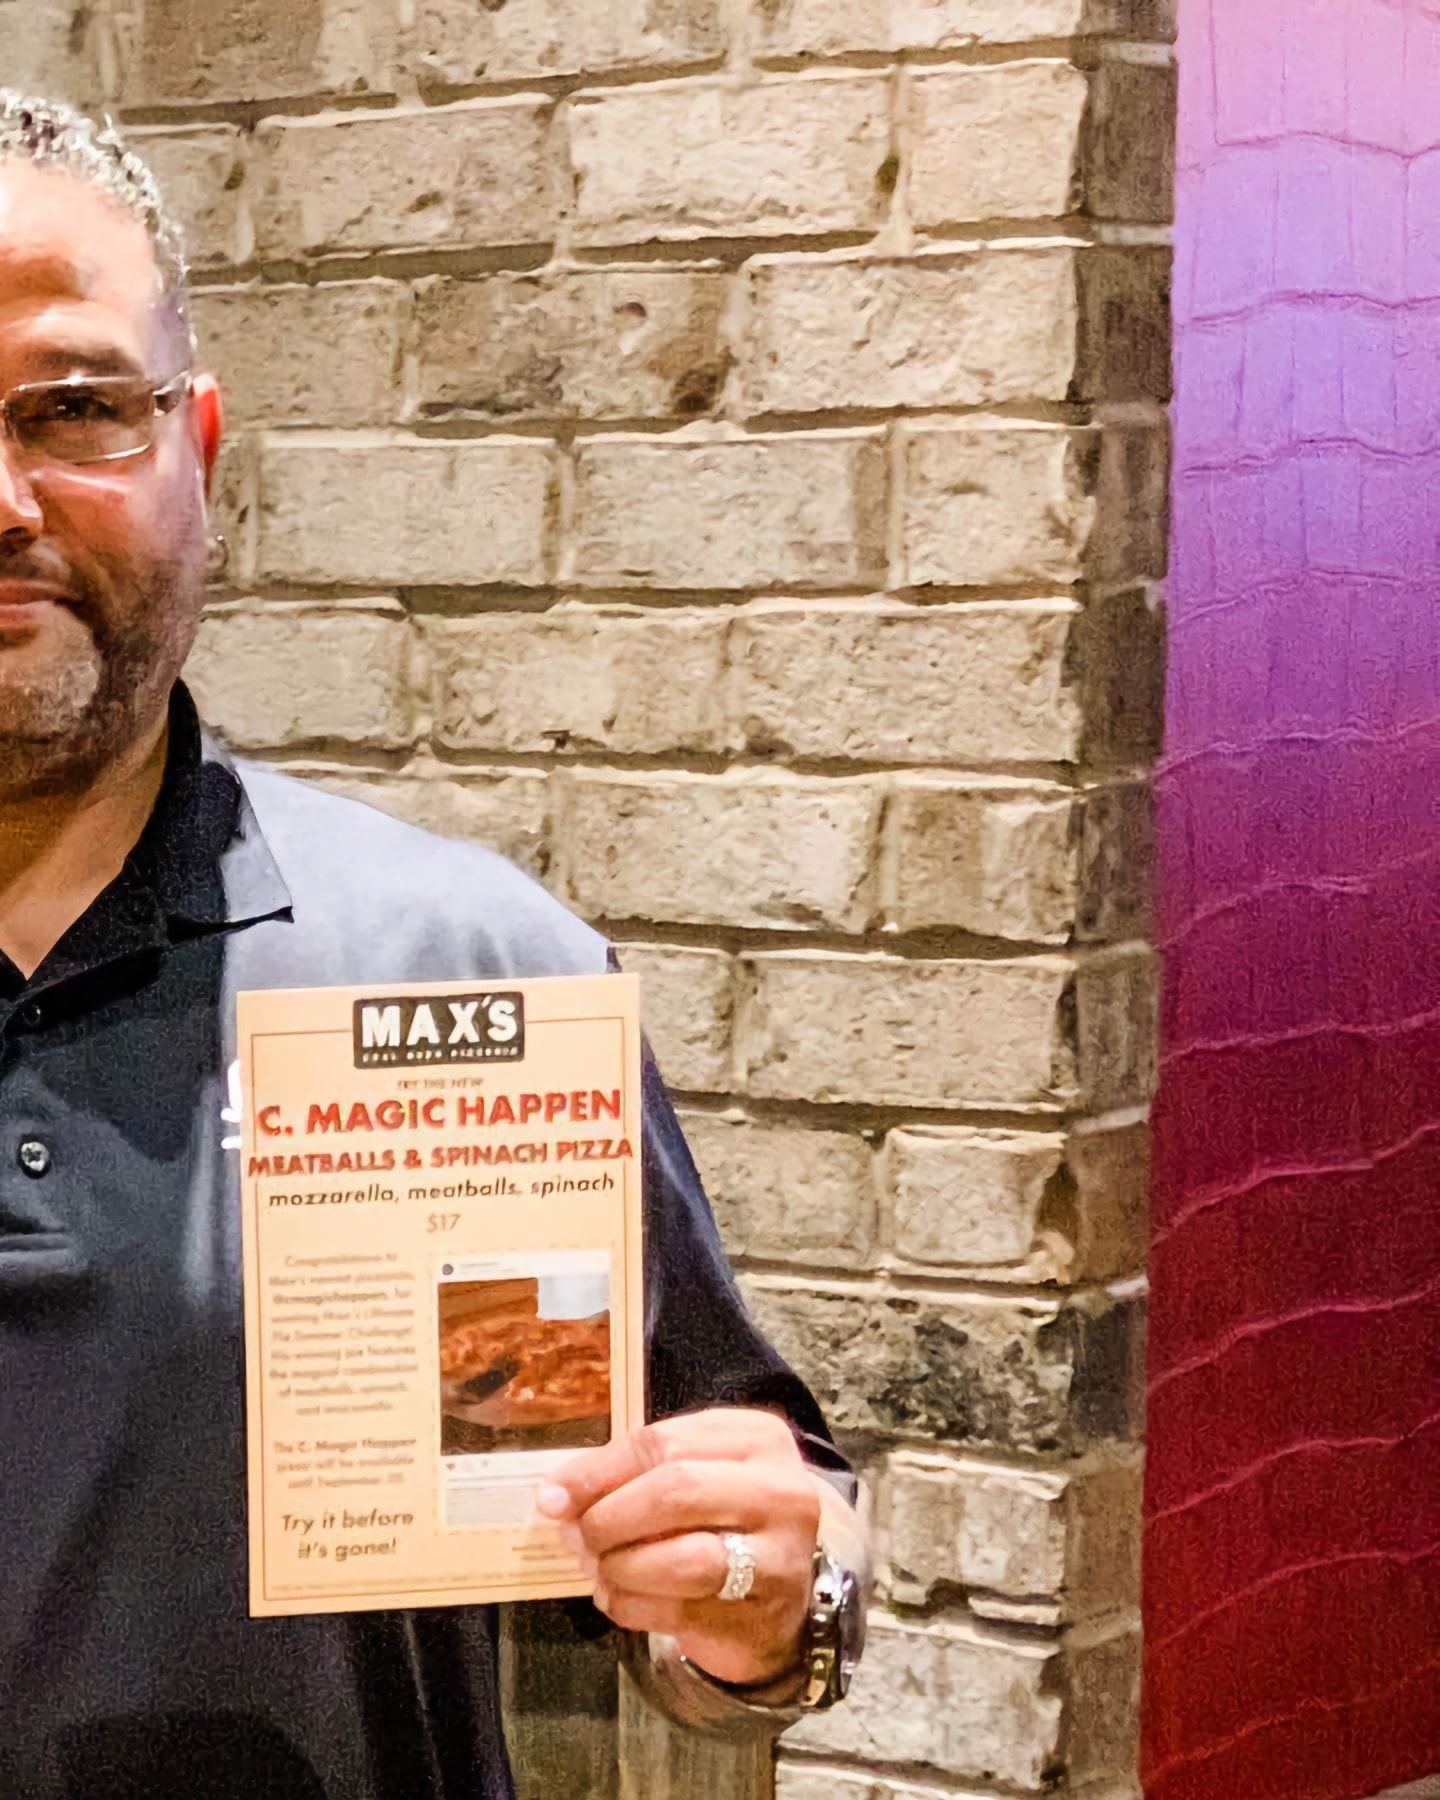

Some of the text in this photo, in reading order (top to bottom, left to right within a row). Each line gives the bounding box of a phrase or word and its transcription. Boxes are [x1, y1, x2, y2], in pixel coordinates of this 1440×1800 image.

[361, 995, 518, 1048] MAX'S
[258, 1089, 621, 1136] C. MAGIC HAPPEN
[248, 1138, 634, 1178] MEATBALLS & SPINACH PIZZA
[269, 1183, 400, 1207] mozzarella,
[530, 1172, 614, 1199] spinach
[426, 1212, 461, 1234] $17
[282, 1508, 414, 1536] Try it before
[298, 1537, 397, 1562] it's gone!
